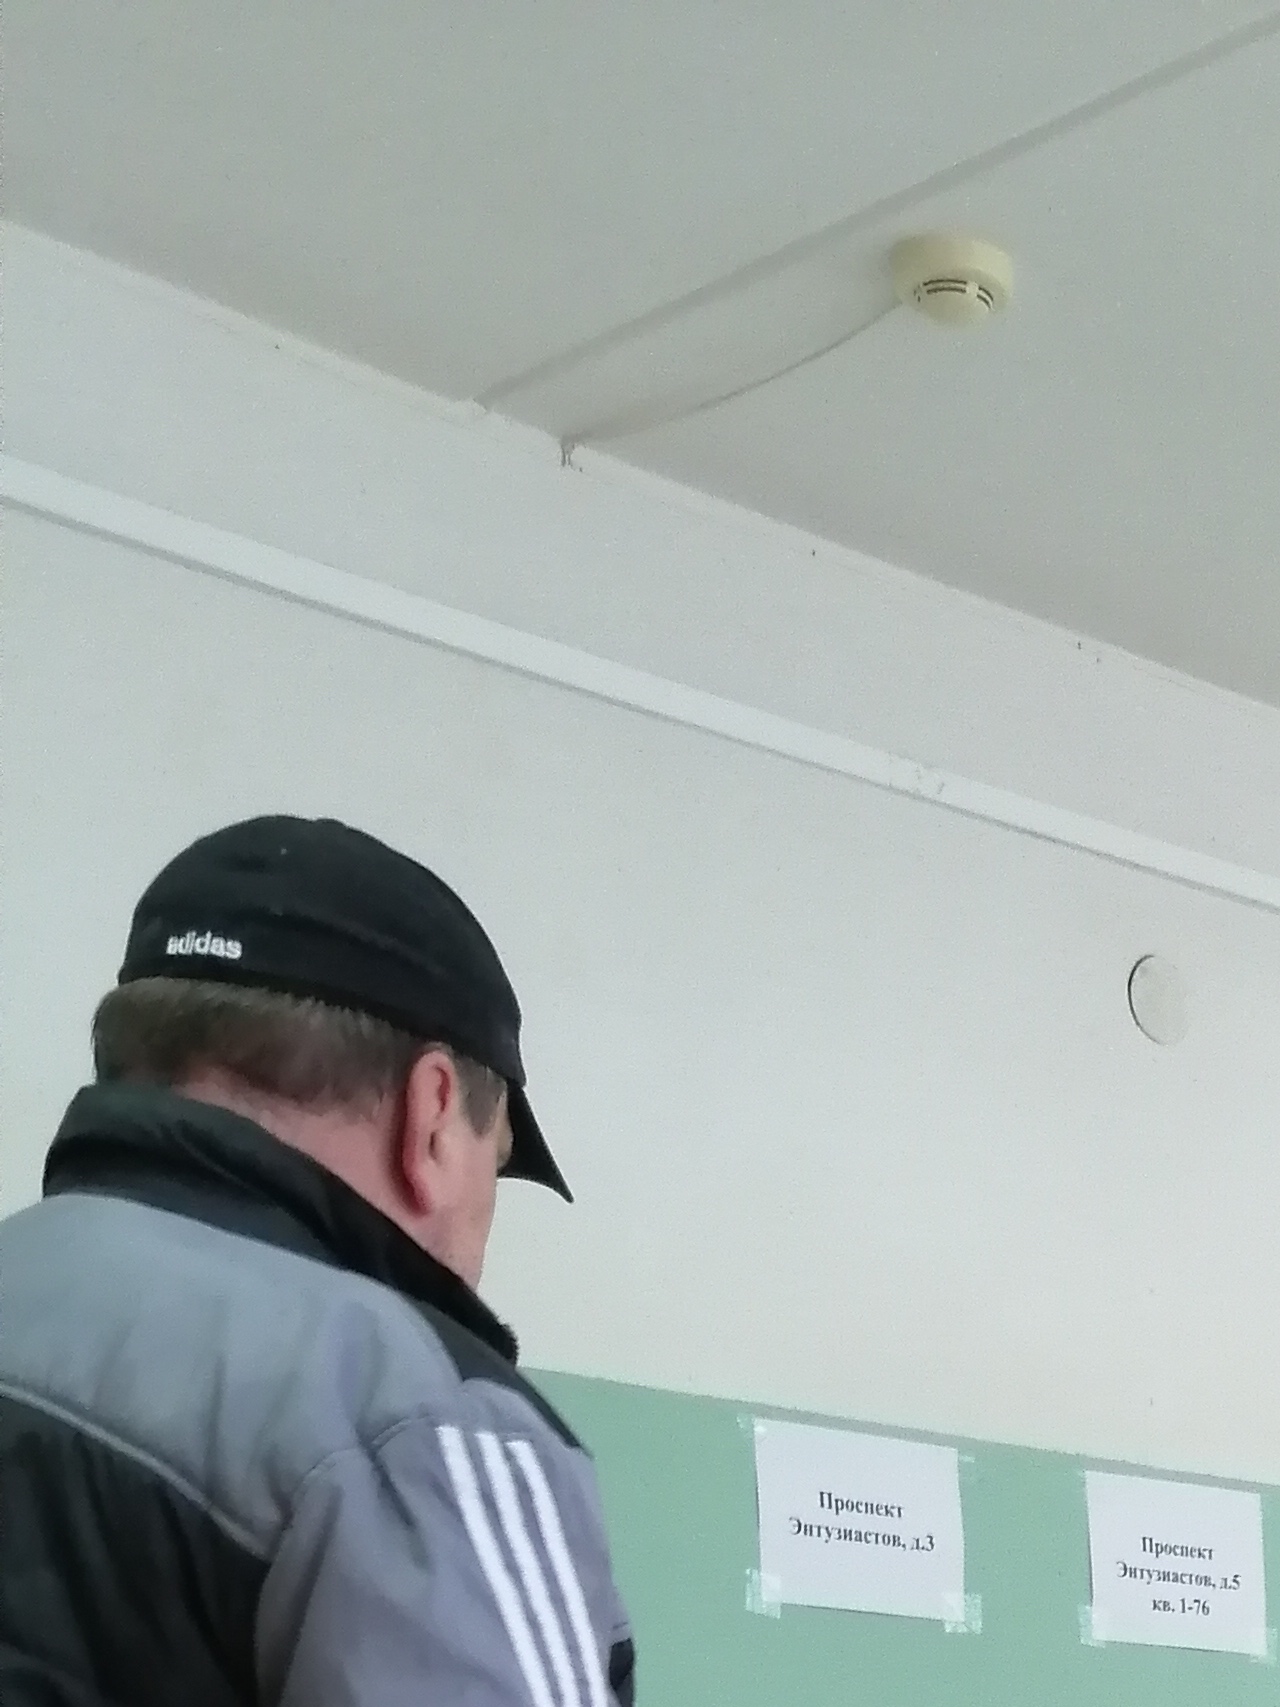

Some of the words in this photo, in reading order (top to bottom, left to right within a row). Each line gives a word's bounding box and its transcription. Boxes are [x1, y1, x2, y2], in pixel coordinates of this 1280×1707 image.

[166, 930, 242, 959] adidas
[819, 1490, 904, 1518] Проспект
[788, 1516, 907, 1551] Энтузиастов,
[910, 1533, 935, 1552] д.3
[1141, 1536, 1214, 1560] Проспект
[1116, 1560, 1217, 1590] Энтузиастов,
[1219, 1573, 1242, 1591] д.5
[1152, 1598, 1176, 1613] кв.
[1179, 1597, 1211, 1616] 1-76
